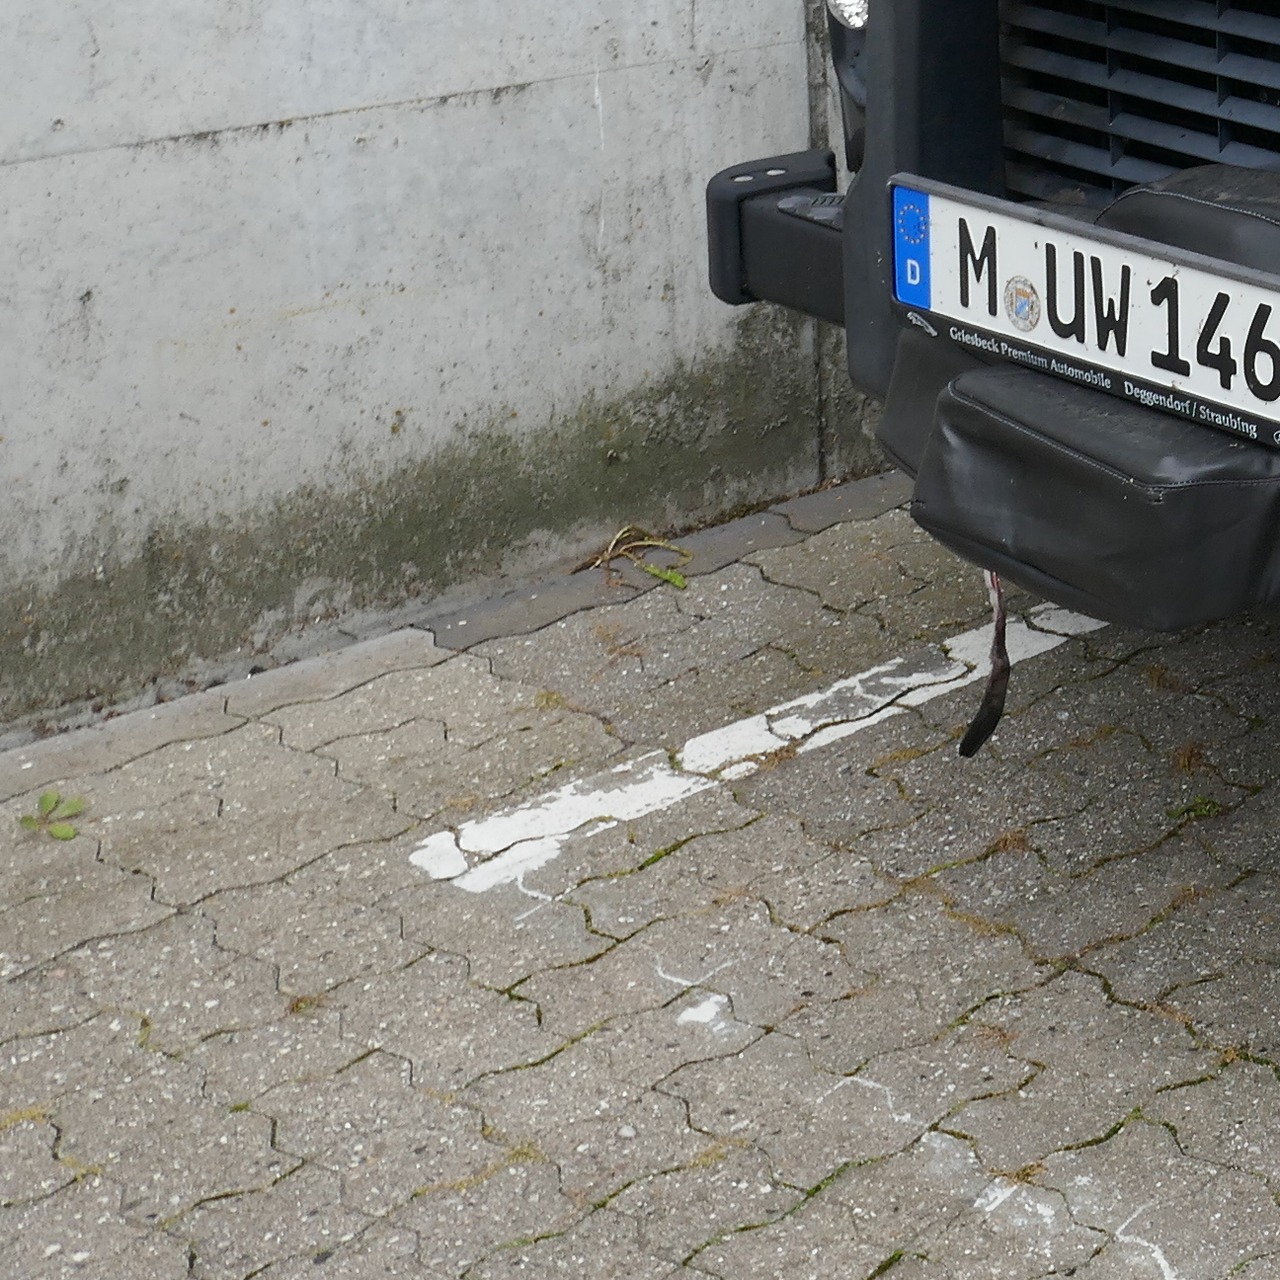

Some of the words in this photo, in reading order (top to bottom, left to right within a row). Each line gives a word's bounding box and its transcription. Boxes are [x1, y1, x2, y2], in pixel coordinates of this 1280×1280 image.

[907, 259, 920, 285] D
[959, 217, 997, 316] M
[1046, 243, 1131, 357] UW
[950, 327, 999, 354] Griesbeck
[1001, 342, 1048, 370] Premium
[1051, 358, 1111, 389] Automobile
[1124, 380, 1191, 415] Deggendorf
[1199, 405, 1257, 438] Straubing
